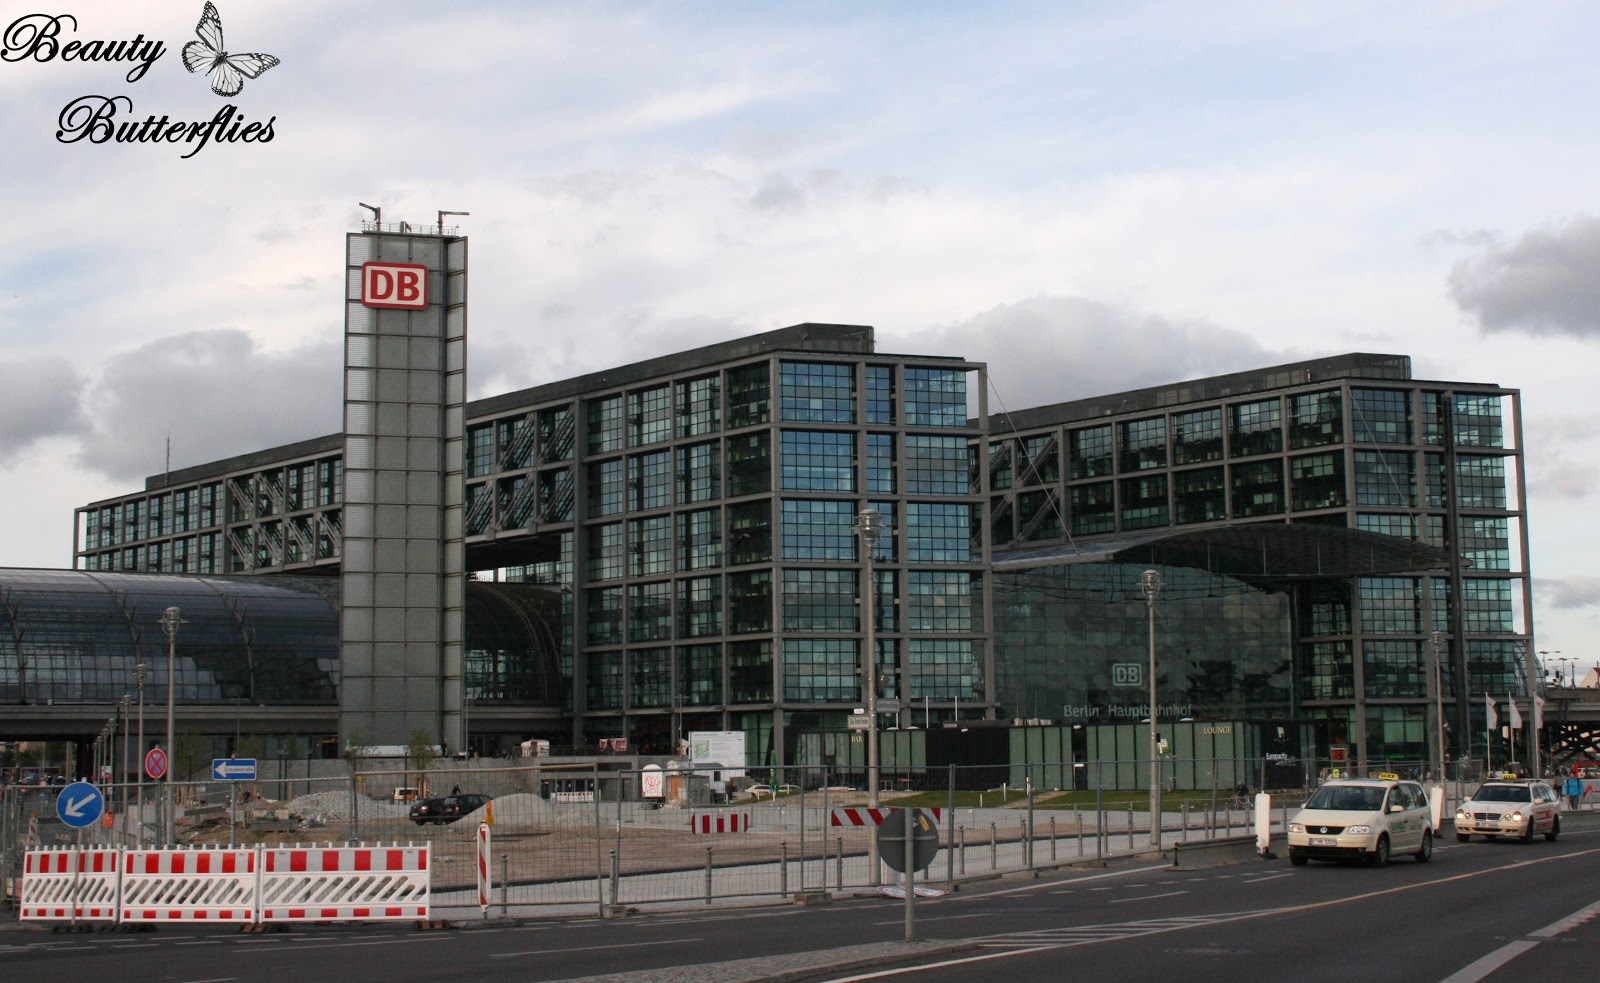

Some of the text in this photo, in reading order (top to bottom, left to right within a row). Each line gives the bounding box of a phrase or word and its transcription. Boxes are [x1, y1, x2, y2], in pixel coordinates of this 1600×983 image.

[370, 270, 420, 301] DB
[1116, 667, 1139, 682] DB
[1064, 704, 1099, 717] Berlin
[1203, 726, 1232, 735] LOUNGE
